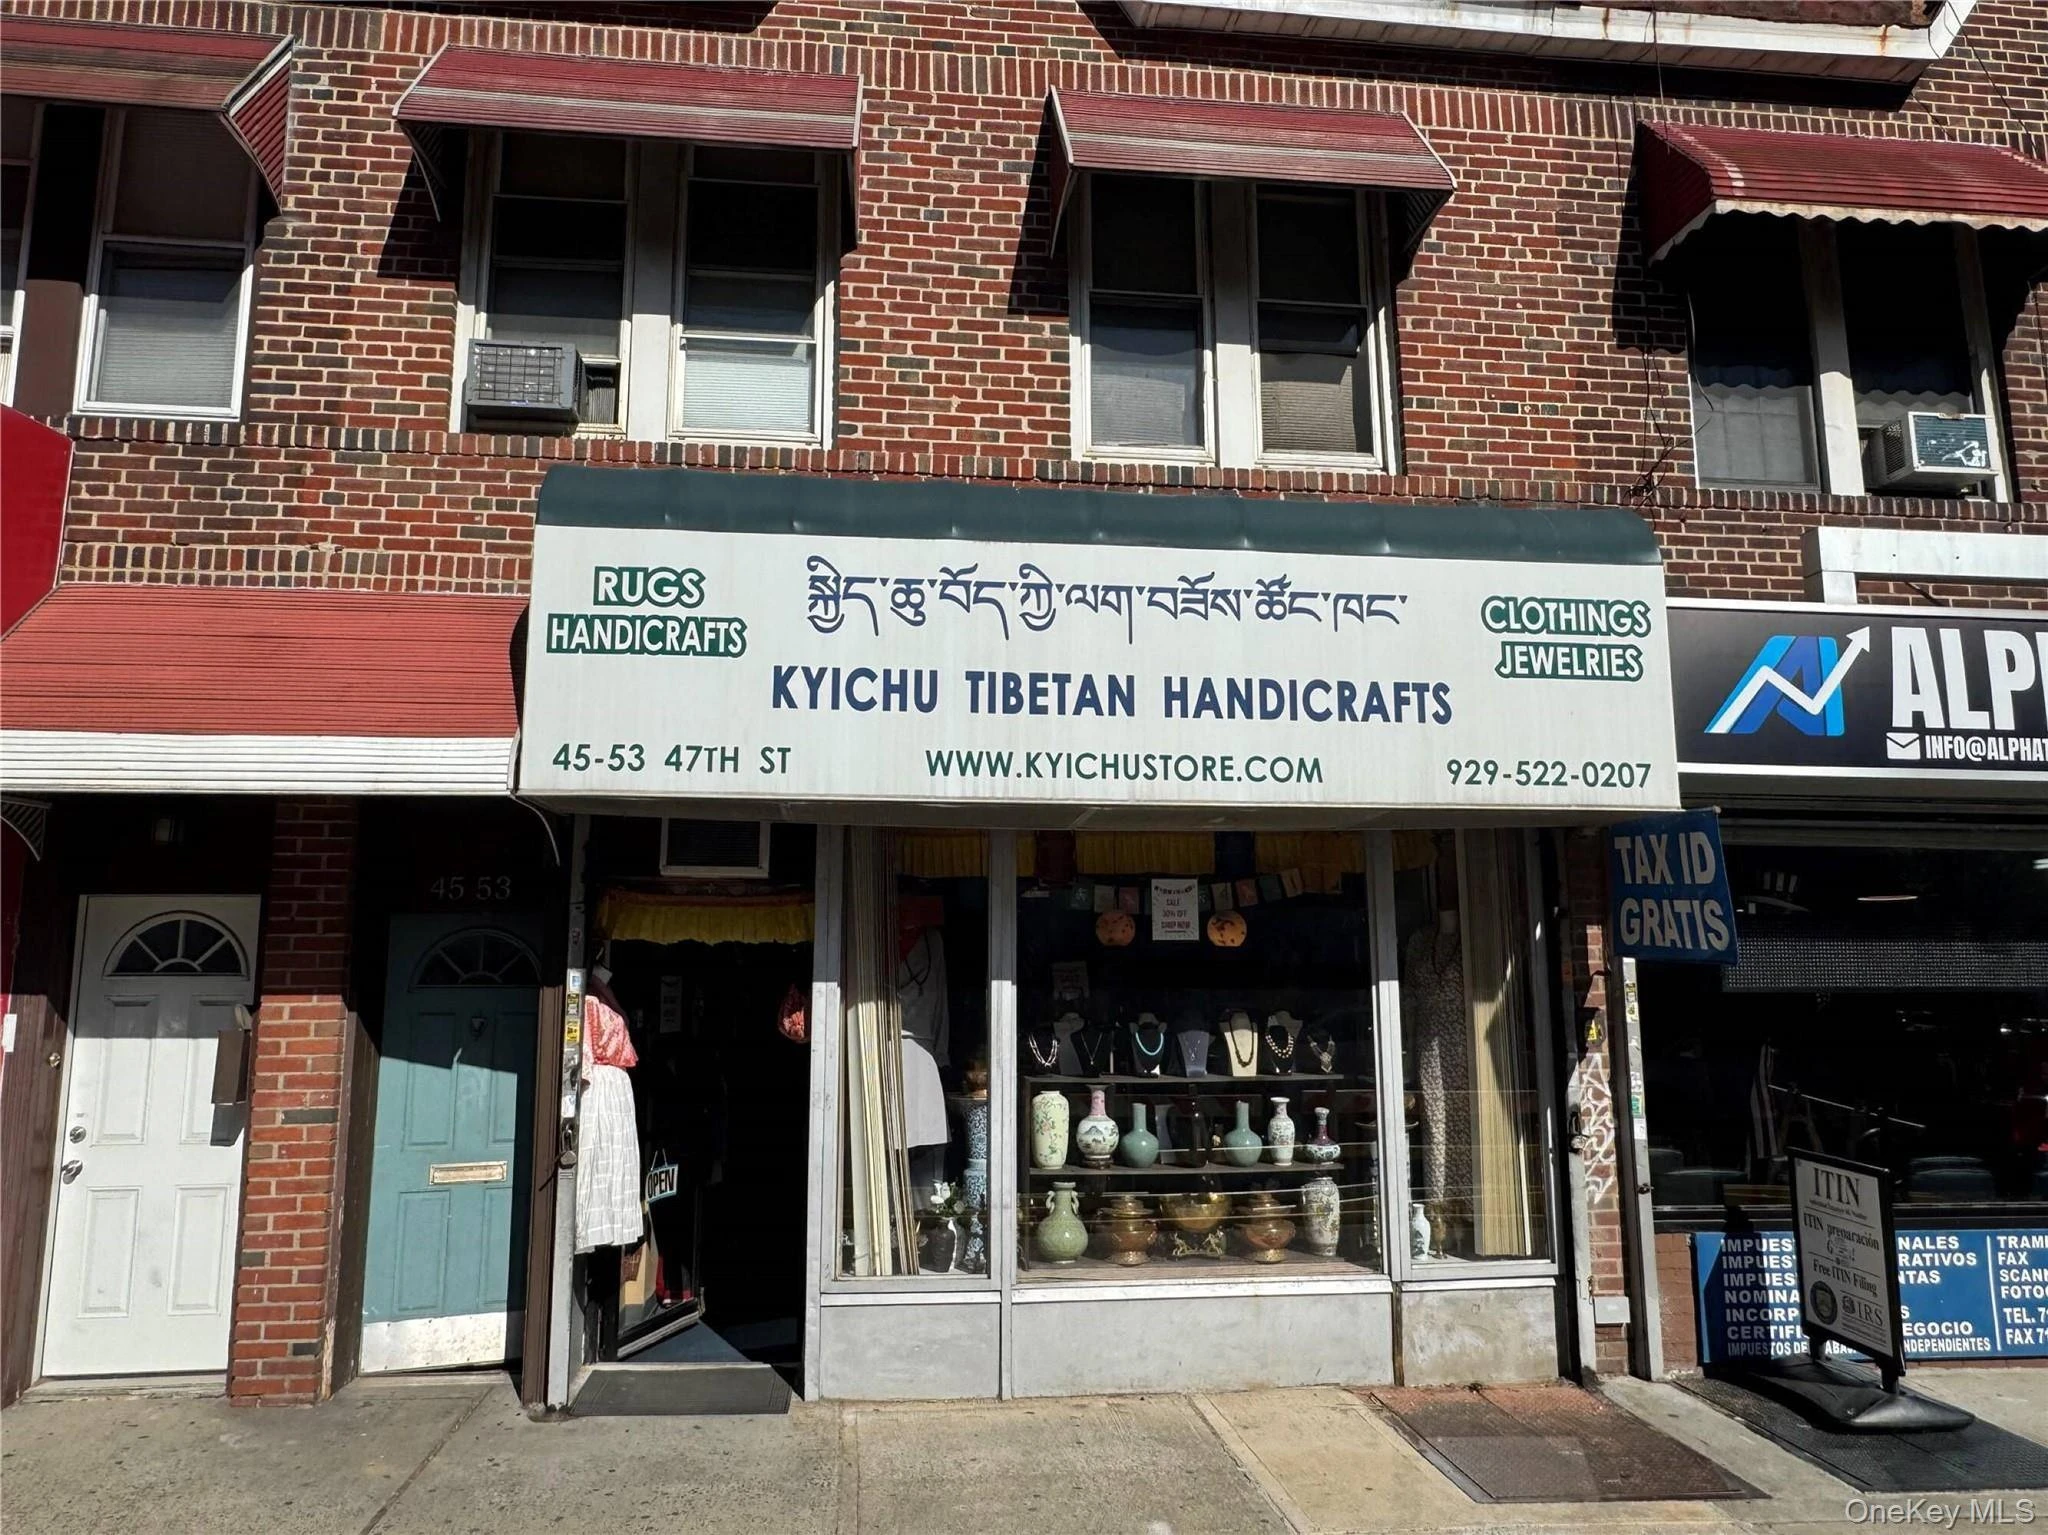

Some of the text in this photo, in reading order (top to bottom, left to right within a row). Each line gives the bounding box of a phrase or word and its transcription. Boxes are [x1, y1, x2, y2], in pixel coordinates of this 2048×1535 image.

[593, 566, 705, 608] RUGS
[1481, 596, 1651, 638] CLOTHINGS
[547, 613, 747, 658] HANDICRAFTS
[1495, 641, 1644, 681] JEWELRIES
[773, 665, 1452, 725] KYICHU TIBETAN HANDICRAFTS
[552, 743, 792, 774] 45-53 47TH ST
[925, 750, 1323, 784] WWW.KYICHUSTORE.COM
[1446, 759, 1652, 788] 929-522-0207
[1614, 831, 1716, 885] TAX ID
[430, 875, 513, 900] 45 53
[1620, 897, 1730, 951] GRATIS
[647, 1167, 675, 1199] OPEN
[1814, 1166, 1860, 1208] ITIN
[1803, 1212, 1824, 1231] ITIN
[1721, 1235, 1960, 1253] IMPUES NALES
[1722, 1252, 1977, 1269] IMPUES RATIVOS
[1997, 1251, 2029, 1266] FAX
[1723, 1272, 1797, 1287] IMPUES
[2000, 1285, 2048, 1299] FOTO
[1725, 1307, 1800, 1323] INCORP
[1857, 1300, 1883, 1327] IRS
[2003, 1307, 2036, 1324] TEL.
[1902, 1321, 1973, 1336] EGOCIO
[2005, 1327, 2036, 1345] FAX
[1903, 1337, 1991, 1353] NDEPENDIENTES
